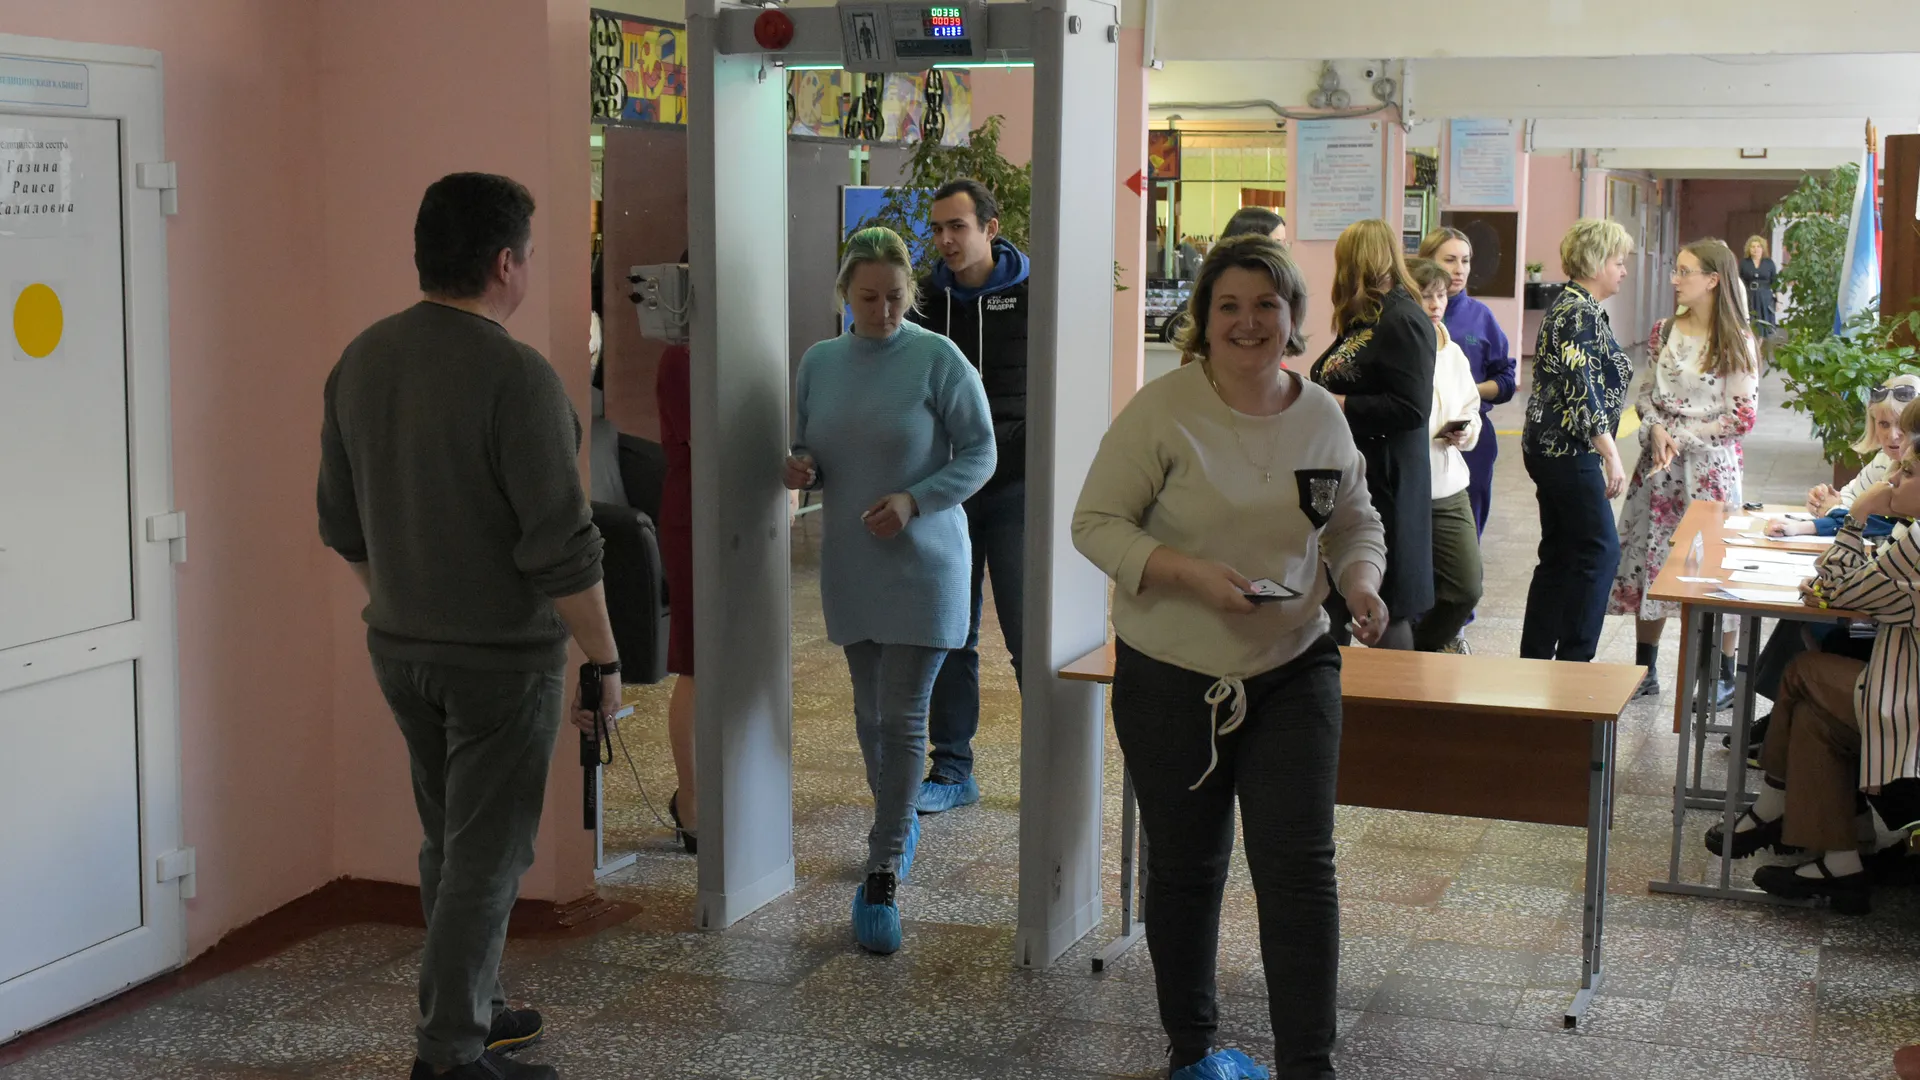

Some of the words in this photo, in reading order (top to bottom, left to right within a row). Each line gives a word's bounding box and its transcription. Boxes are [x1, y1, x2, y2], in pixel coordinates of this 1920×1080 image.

[931, 8, 960, 17] 00336
[932, 16, 961, 26] 00039
[0, 76, 51, 87] ЕДИЦИНСКИЙ
[0, 141, 44, 149] едицинская
[45, 141, 69, 151] сестра
[7, 159, 58, 173] Газина
[12, 180, 55, 194] Раиса
[986, 303, 1015, 311] ЛИДЕРА
